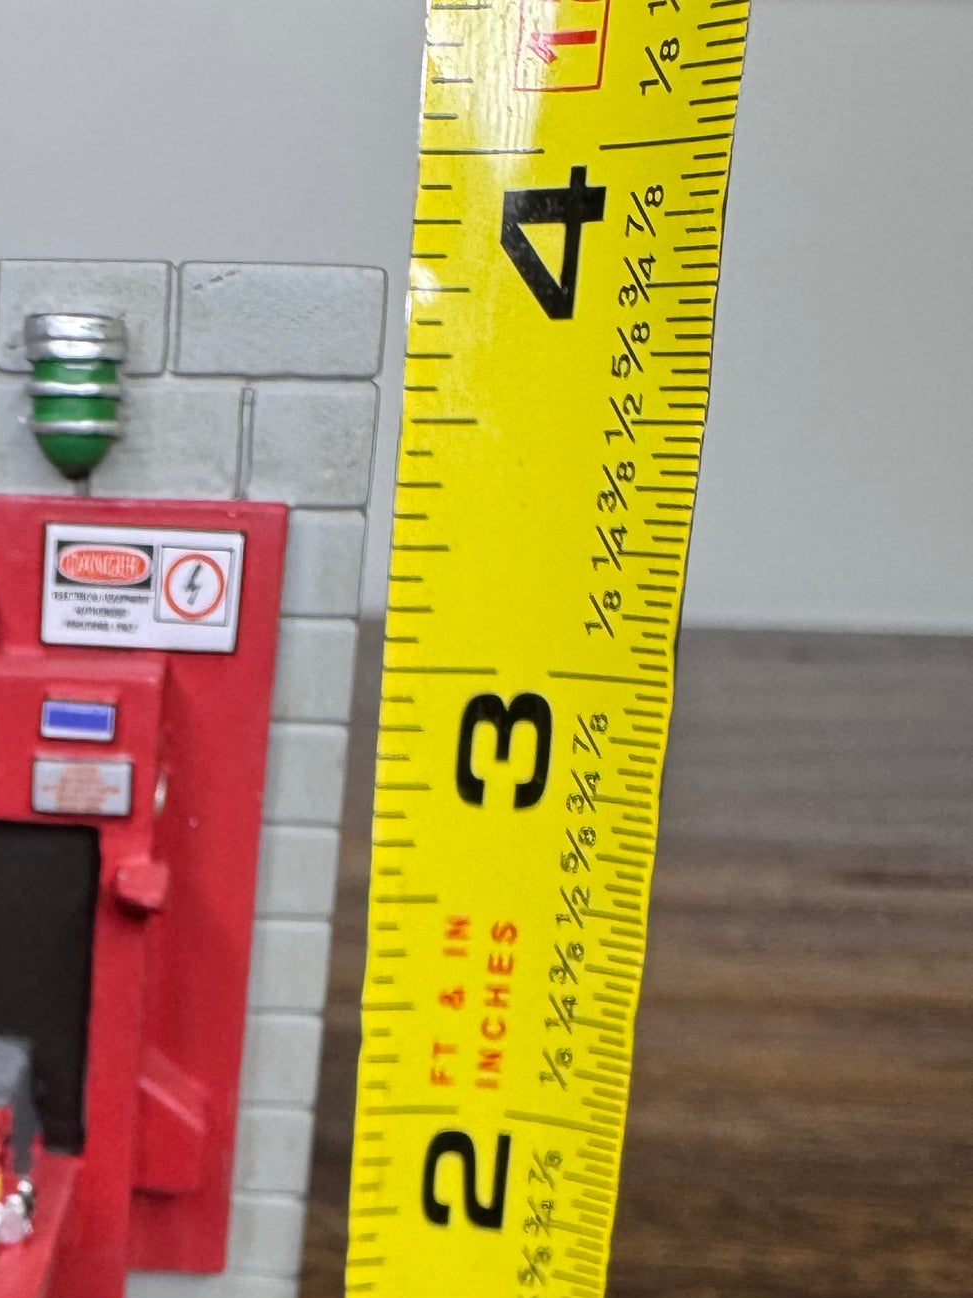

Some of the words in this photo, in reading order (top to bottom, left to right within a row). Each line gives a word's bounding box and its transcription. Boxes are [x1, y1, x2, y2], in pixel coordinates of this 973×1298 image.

[639, 37, 679, 95] 1/8
[625, 185, 664, 237] 7/8
[501, 165, 606, 319] 4
[618, 252, 656, 307] 3/4
[611, 321, 650, 378] 5/8
[603, 393, 643, 445] 1/2
[597, 461, 635, 513] 3/8
[591, 523, 628, 572] 1/4
[584, 590, 622, 639] 1/8
[455, 692, 552, 810] 3
[443, 915, 471, 957] IN
[438, 986, 466, 1010] &
[475, 920, 518, 1090] INCHES
[430, 1042, 457, 1087] FT
[422, 1130, 511, 1231] 2
